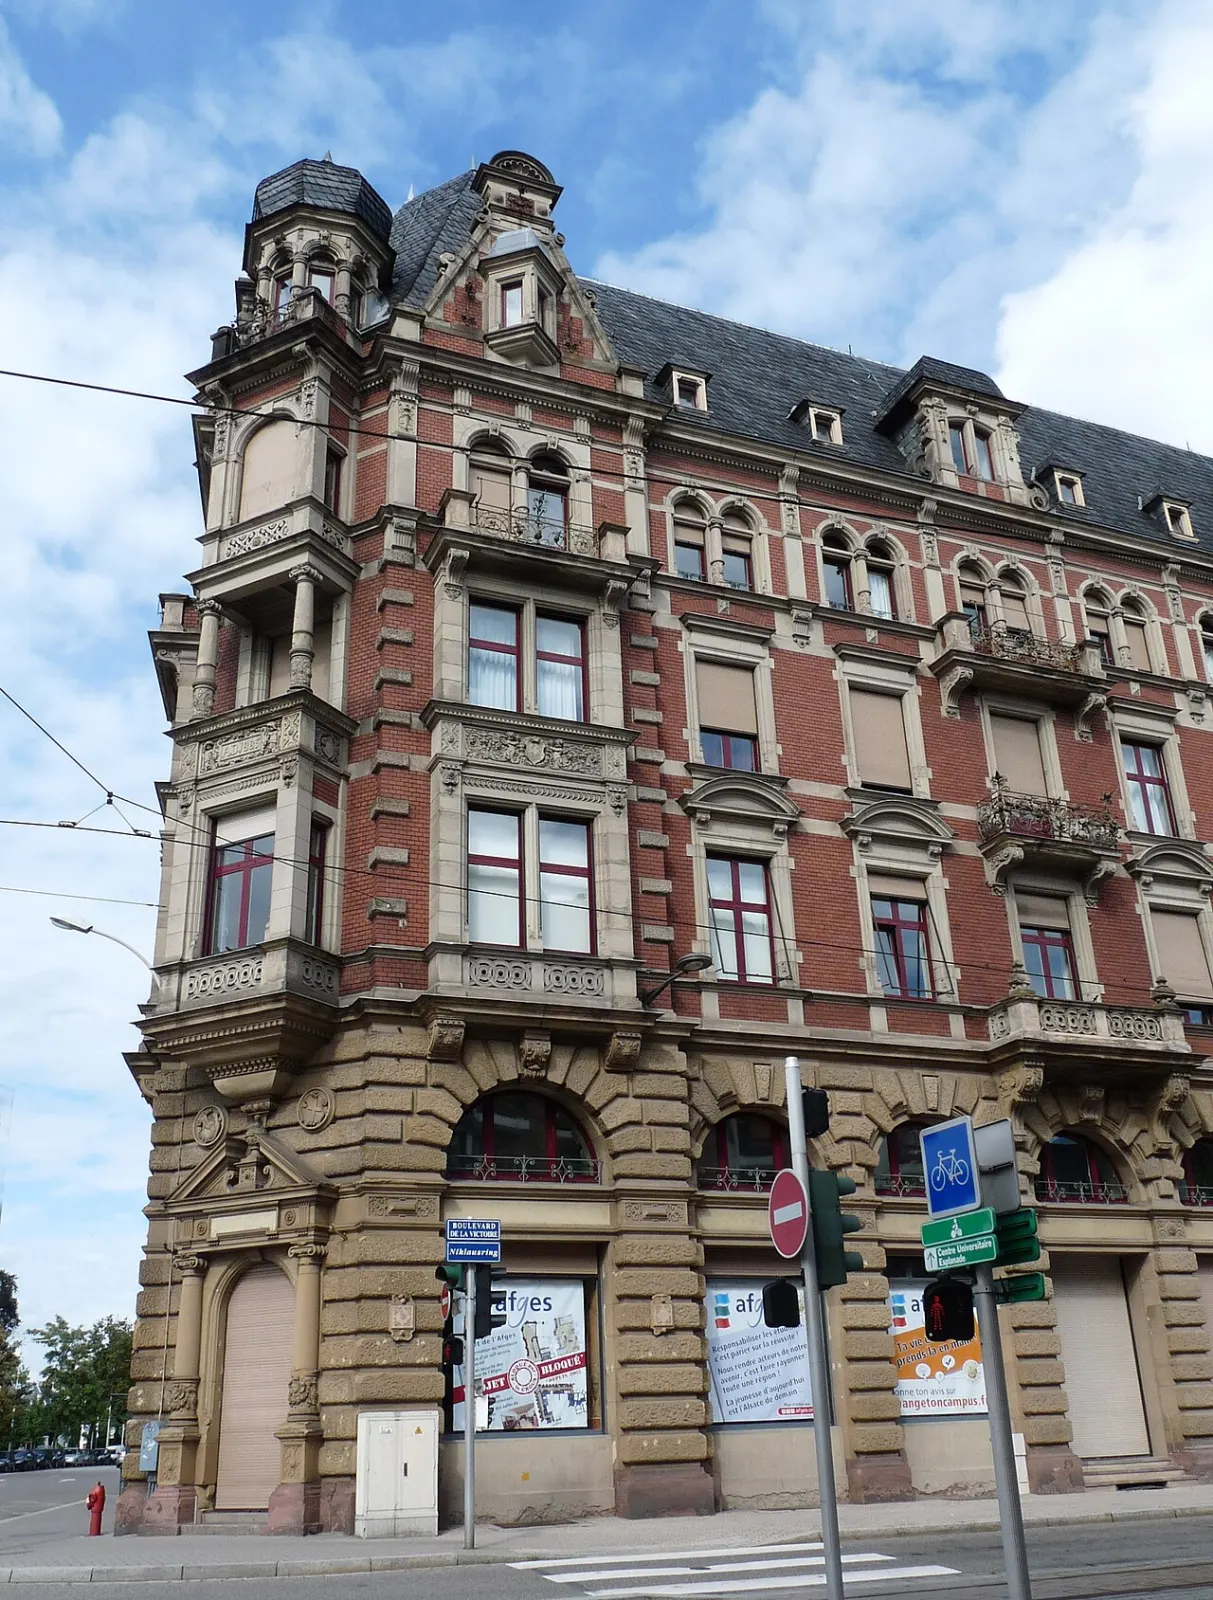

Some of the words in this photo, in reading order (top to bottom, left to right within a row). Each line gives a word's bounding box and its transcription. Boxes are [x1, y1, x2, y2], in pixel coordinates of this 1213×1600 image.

[469, 1230, 498, 1238] VICTOIRE
[449, 1248, 498, 1258] Niklausring
[937, 1247, 956, 1257] Centre
[956, 1239, 992, 1253] Universitaire
[938, 1254, 966, 1267] Esplanade
[495, 1290, 553, 1328] afges
[736, 1292, 764, 1328] afg
[712, 1333, 761, 1353] Responsabiliser
[762, 1330, 773, 1339] les
[714, 1353, 730, 1363] c'est
[731, 1347, 750, 1360] parier
[752, 1344, 762, 1352] sur
[763, 1340, 770, 1348] la
[896, 1342, 908, 1352] Ta
[909, 1338, 923, 1349] vie
[717, 1365, 734, 1376] Nous
[735, 1358, 757, 1371] rendre
[757, 1351, 781, 1363] acteurs
[781, 1347, 789, 1355] de
[790, 1342, 808, 1353] notre
[896, 1347, 937, 1368] prends-la
[939, 1344, 950, 1352] en
[720, 1372, 743, 1385] avenir,
[744, 1367, 759, 1377] c'est
[760, 1362, 775, 1373] faire
[776, 1353, 805, 1367] rayonner
[722, 1383, 740, 1394] toute
[741, 1378, 754, 1387] une
[755, 1372, 777, 1385] région
[896, 1388, 914, 1396] onne
[915, 1388, 929, 1396] ton
[930, 1387, 945, 1396] avis
[946, 1387, 957, 1395] sur
[725, 1399, 734, 1407] La
[735, 1389, 762, 1404] jeunesse
[728, 1407, 739, 1416] est
[739, 1400, 764, 1412] l'Alsace
[765, 1396, 773, 1404] de
[900, 1395, 986, 1410] angetoncampus.f
